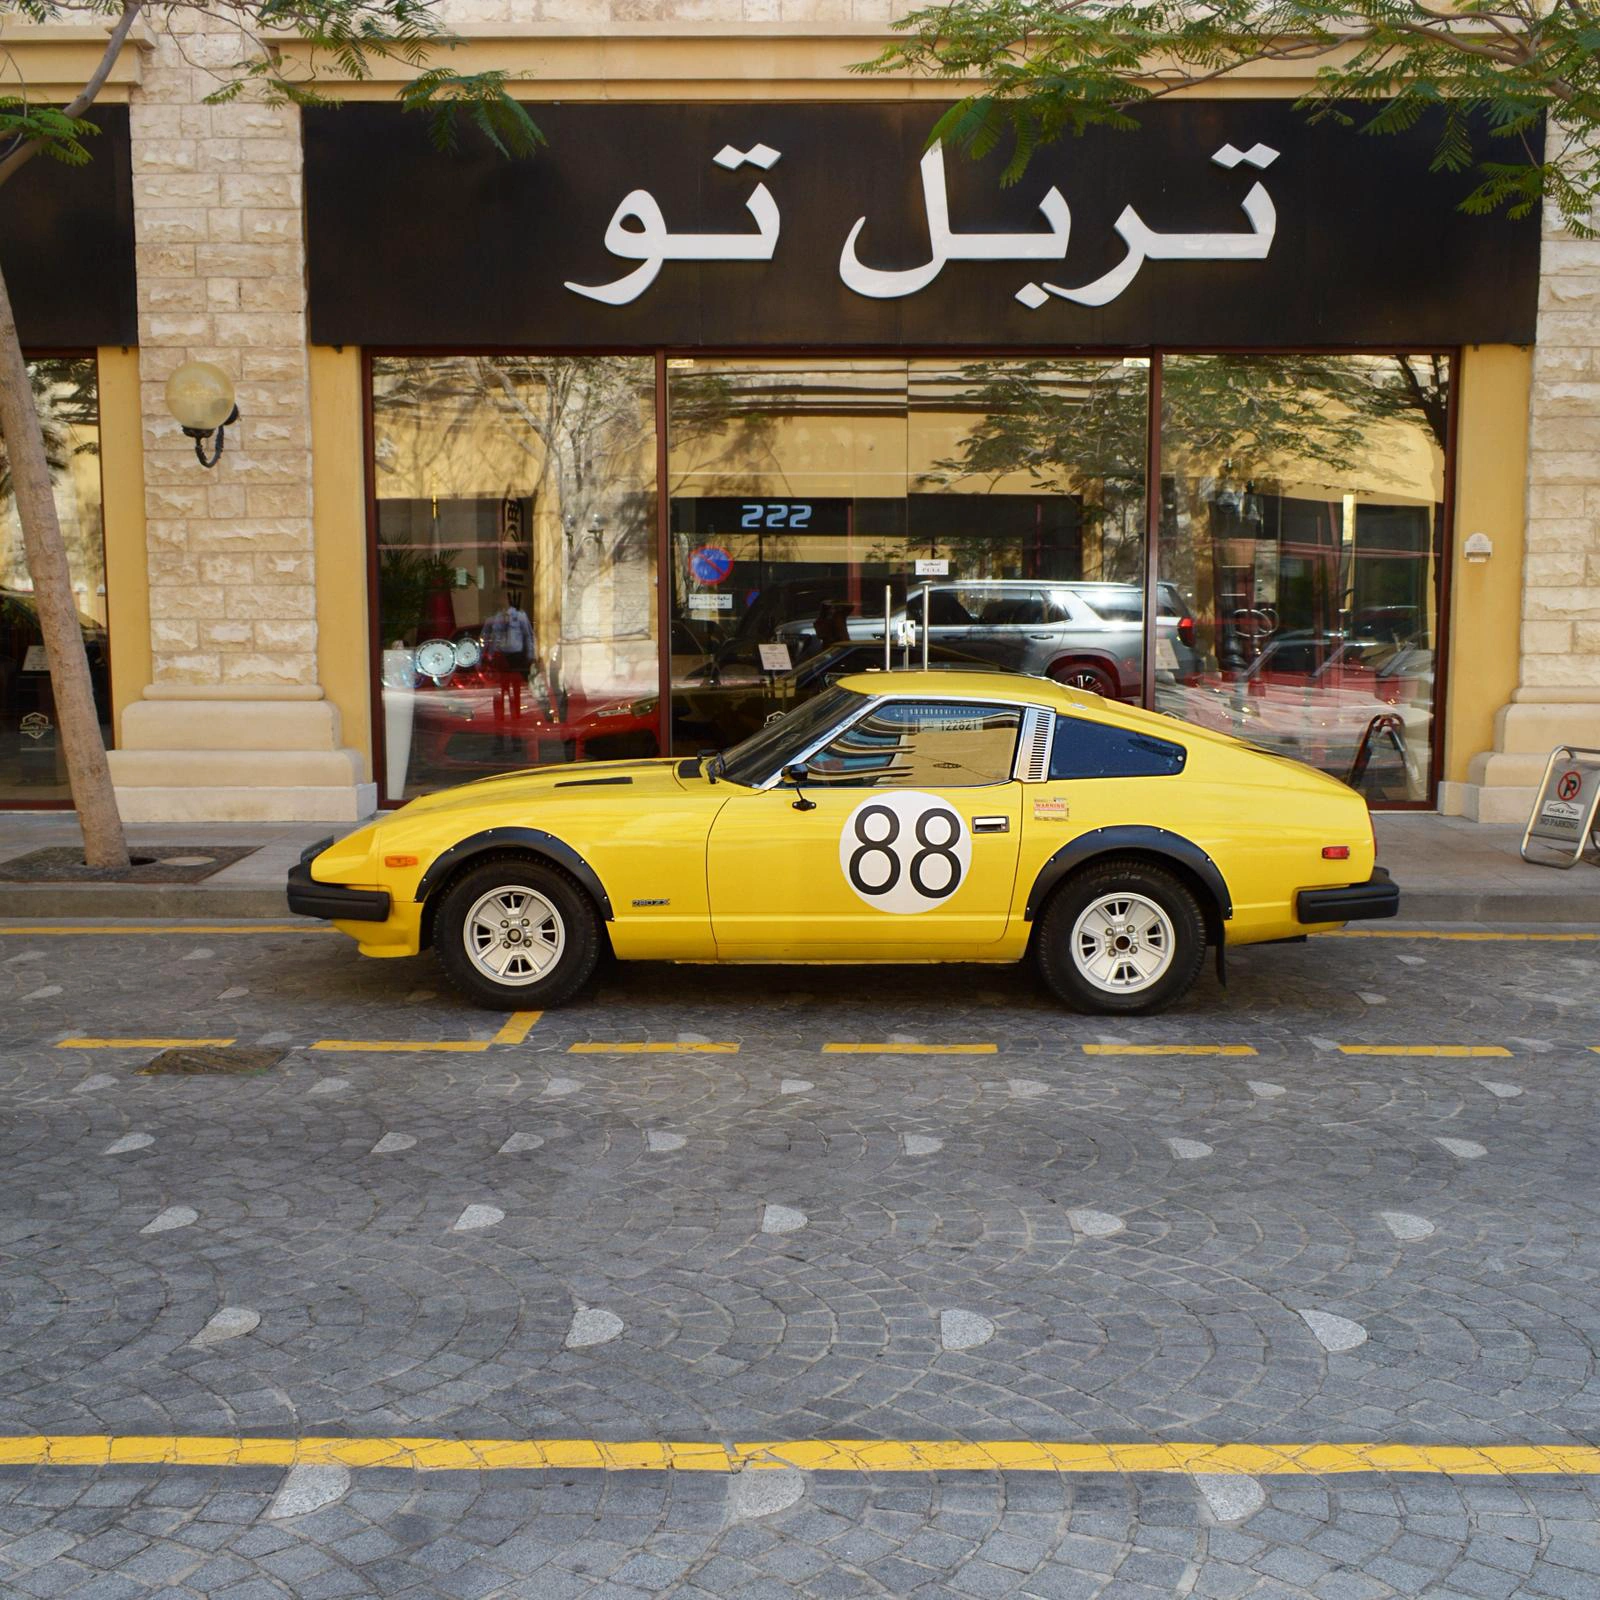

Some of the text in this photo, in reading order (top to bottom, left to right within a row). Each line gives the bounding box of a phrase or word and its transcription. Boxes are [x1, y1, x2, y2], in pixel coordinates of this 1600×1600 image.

[564, 139, 1280, 308] تربل تو
[741, 504, 812, 528] 222
[849, 804, 962, 899] 88
[1540, 817, 1578, 829] NO PARKING
